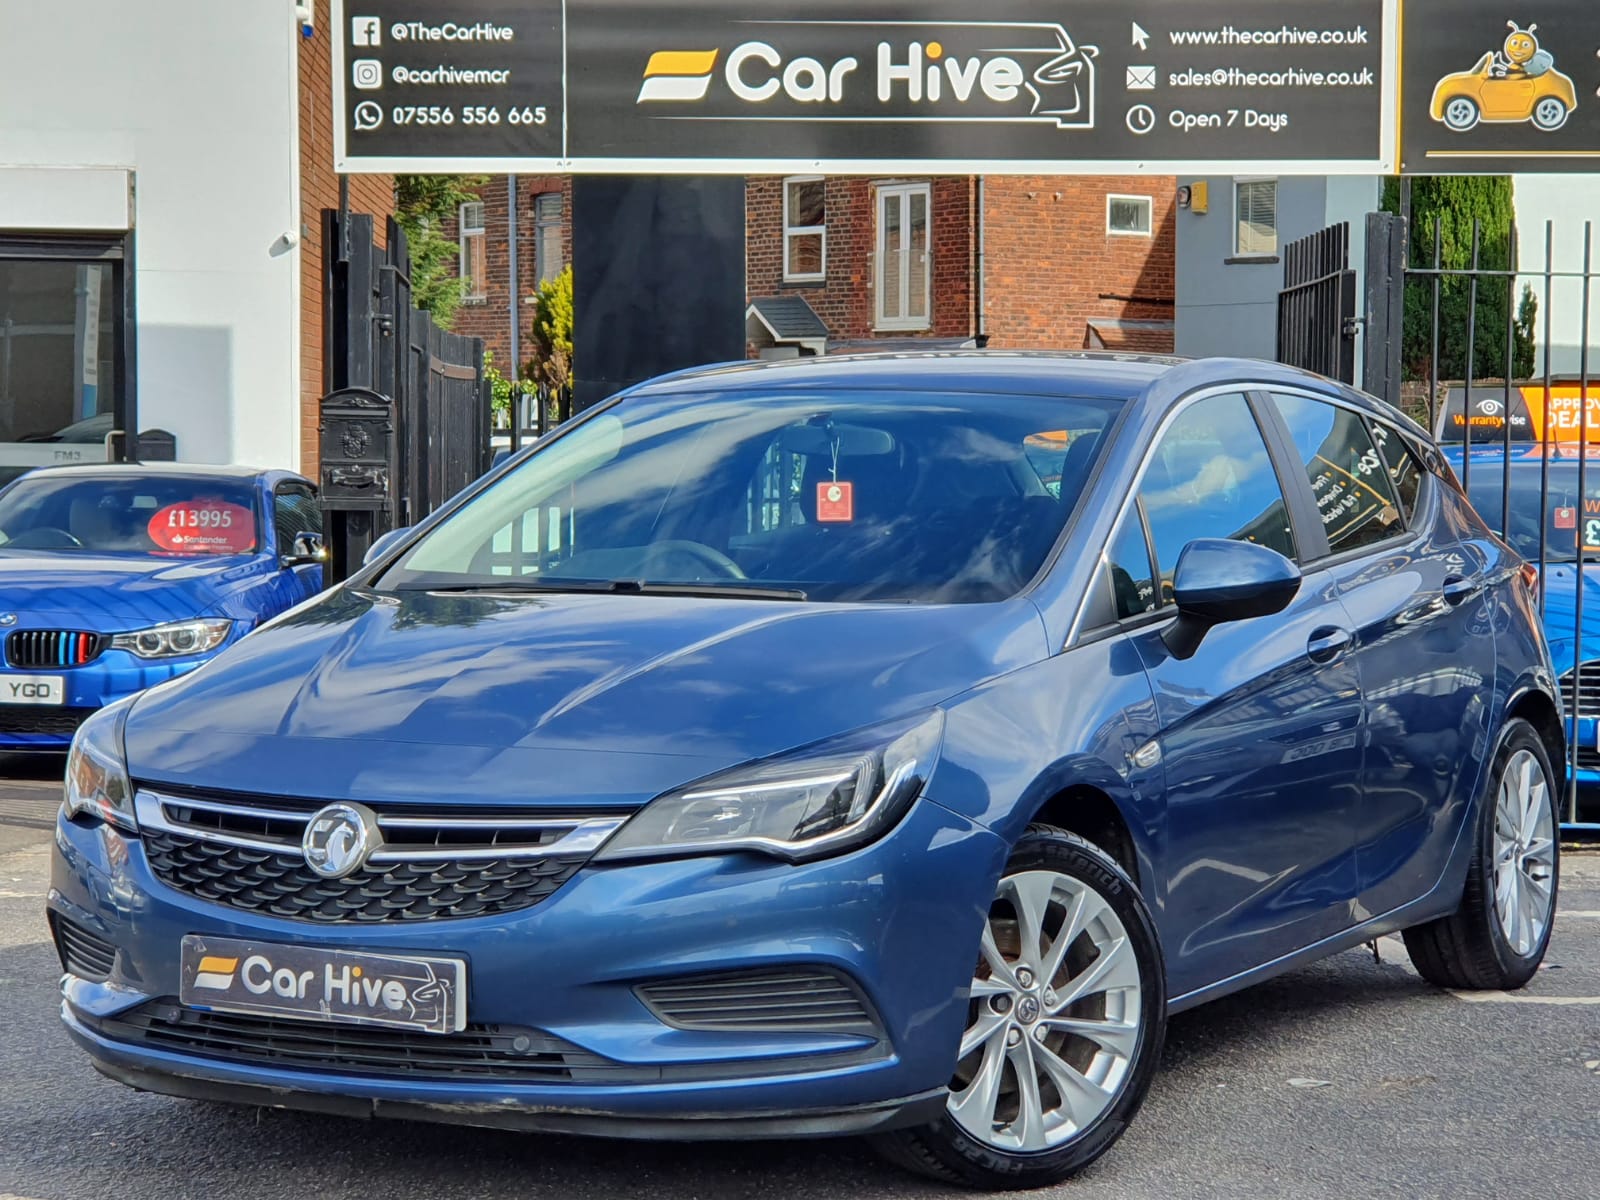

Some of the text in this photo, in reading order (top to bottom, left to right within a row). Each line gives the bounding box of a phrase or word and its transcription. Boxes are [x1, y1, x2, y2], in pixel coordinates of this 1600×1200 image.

[391, 22, 513, 41] @TheCarHive
[1169, 26, 1368, 45] www.thecarhive.co.uk
[392, 65, 510, 84] @carhivemcr
[725, 41, 1024, 102] Car Hive
[1169, 67, 1374, 88] sales@thecarhive.co.uk
[393, 107, 547, 124] 07556 556 665
[1169, 110, 1288, 132] Open 7 Days
[168, 510, 232, 528] £13995
[183, 535, 228, 544] Santander
[9, 682, 51, 698] YGO
[241, 955, 407, 1010] Car Hive
